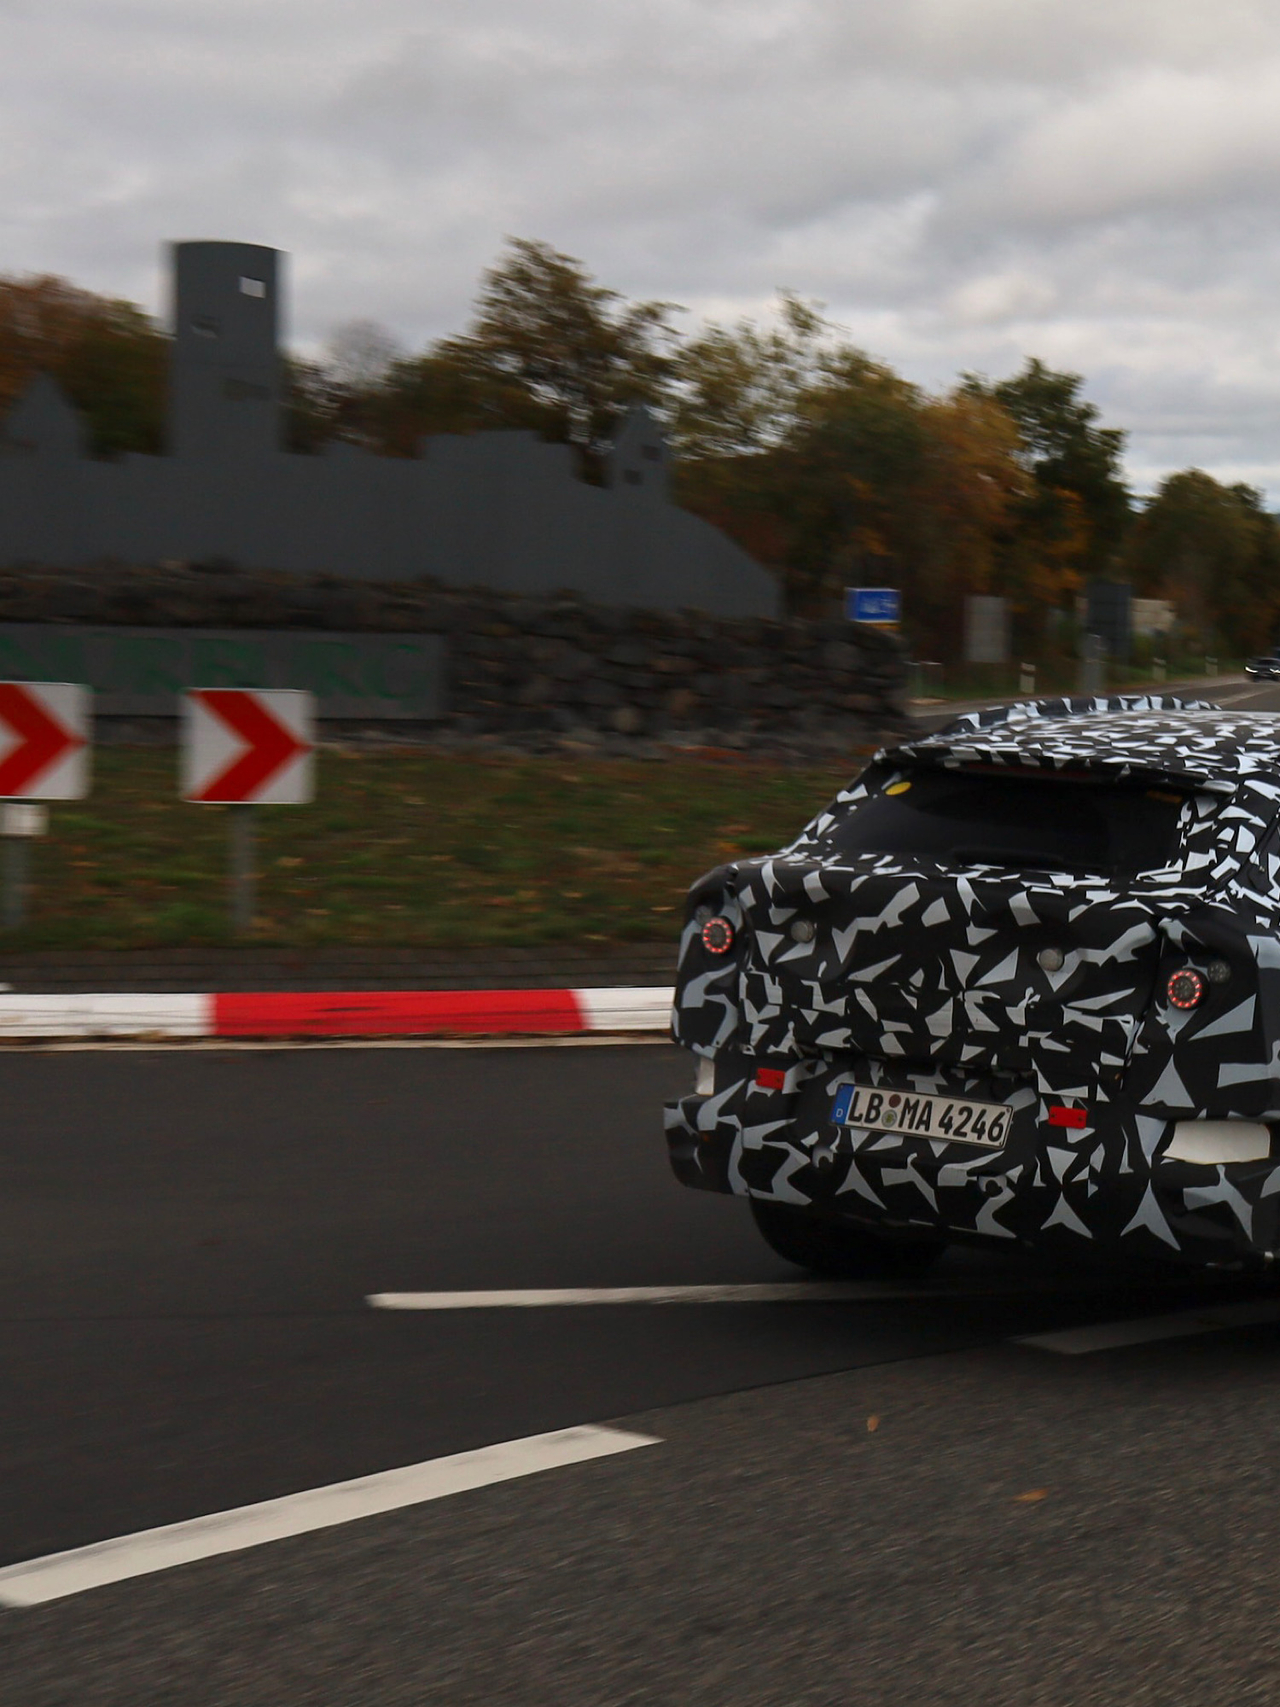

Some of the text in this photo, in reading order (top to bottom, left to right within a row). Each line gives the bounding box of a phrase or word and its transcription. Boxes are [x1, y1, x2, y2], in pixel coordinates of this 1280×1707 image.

[836, 1108, 843, 1118] D
[848, 1091, 1006, 1142] LB MA 4246
